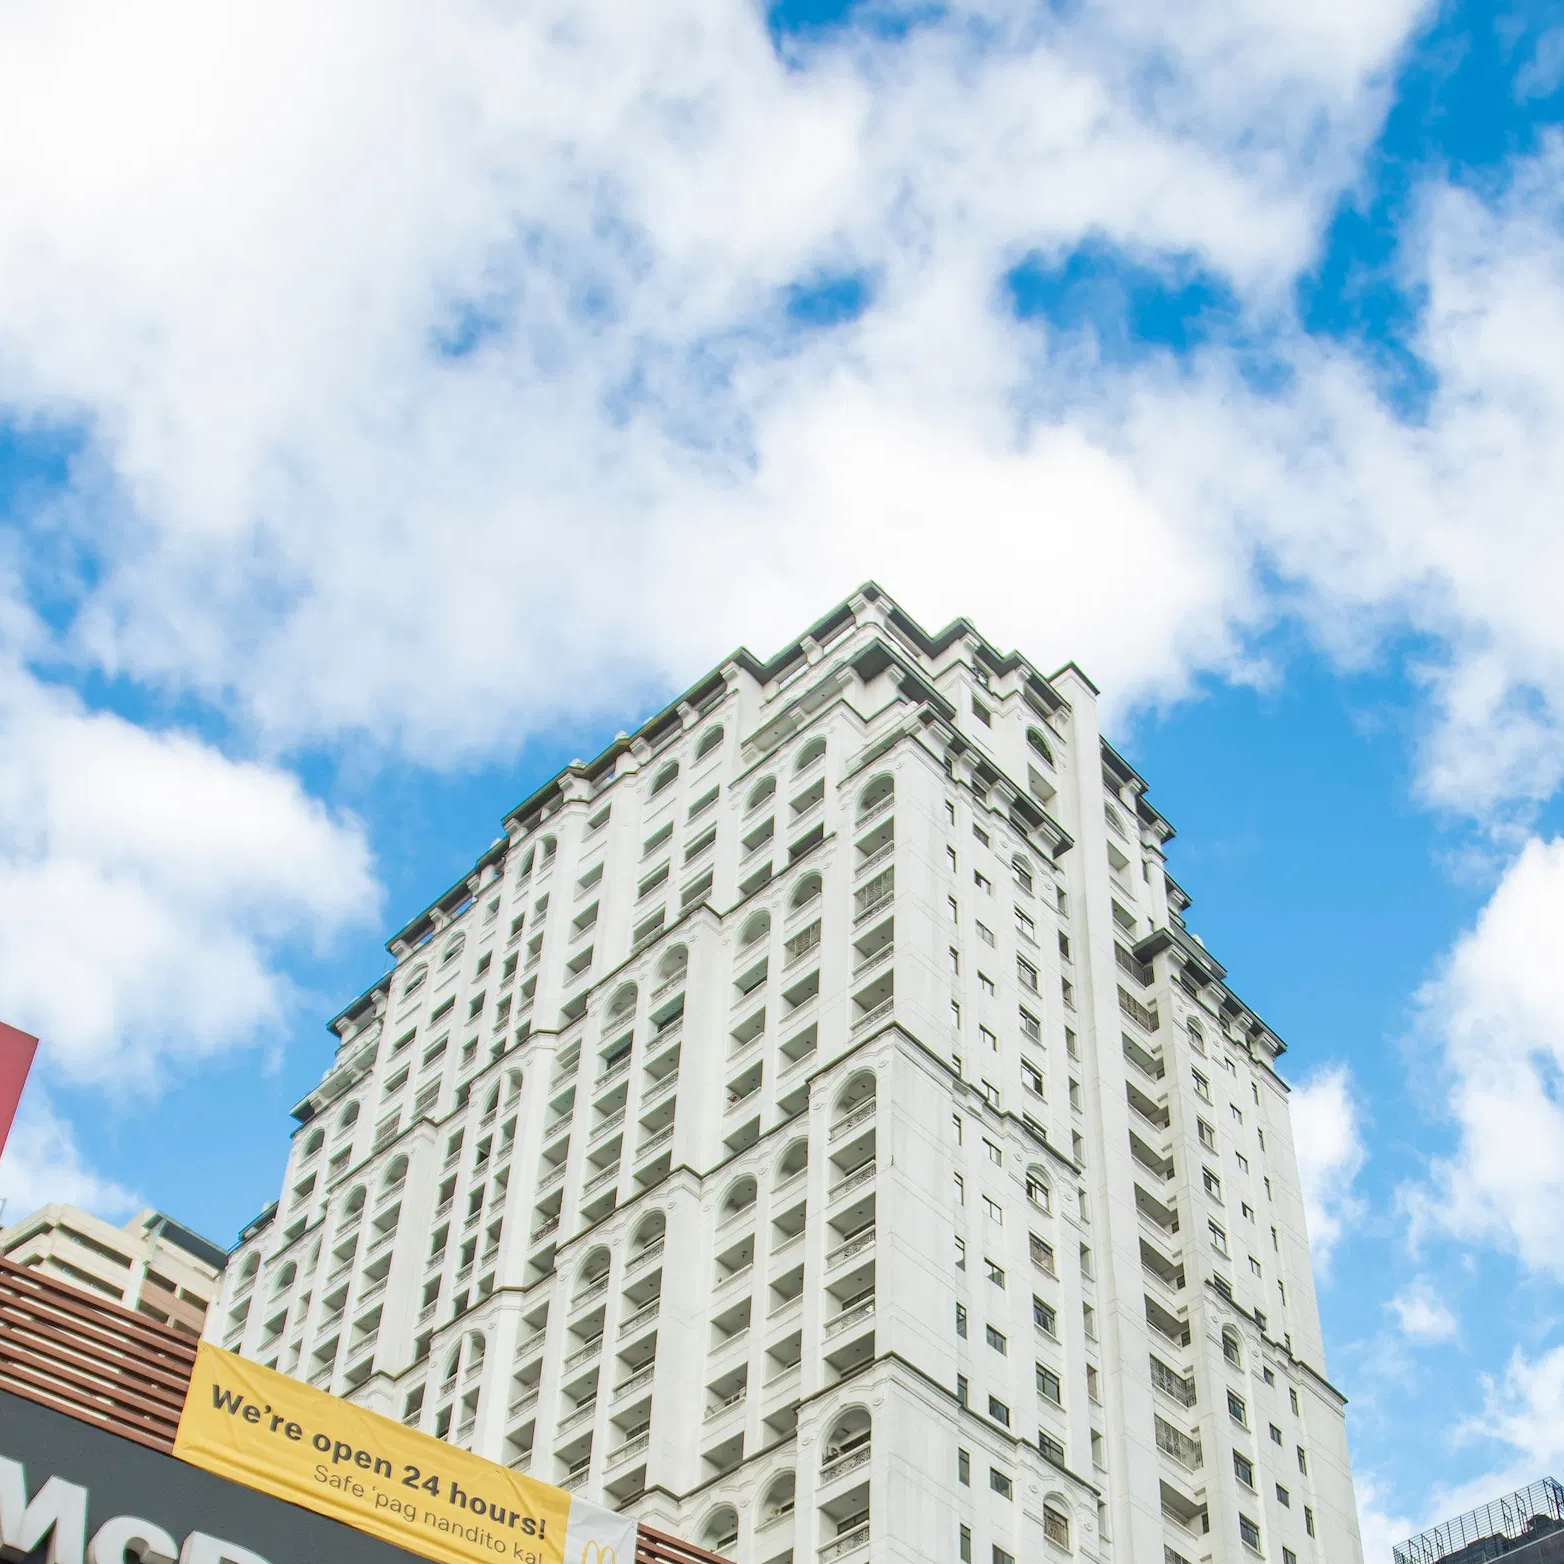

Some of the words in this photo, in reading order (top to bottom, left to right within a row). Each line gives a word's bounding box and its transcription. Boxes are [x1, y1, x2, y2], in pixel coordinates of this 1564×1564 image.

[212, 1384, 303, 1442] We're
[312, 1433, 393, 1479] open
[403, 1465, 440, 1497] 24
[450, 1482, 546, 1541] hours!
[314, 1464, 365, 1499] Safe
[424, 1511, 507, 1556] nandito
